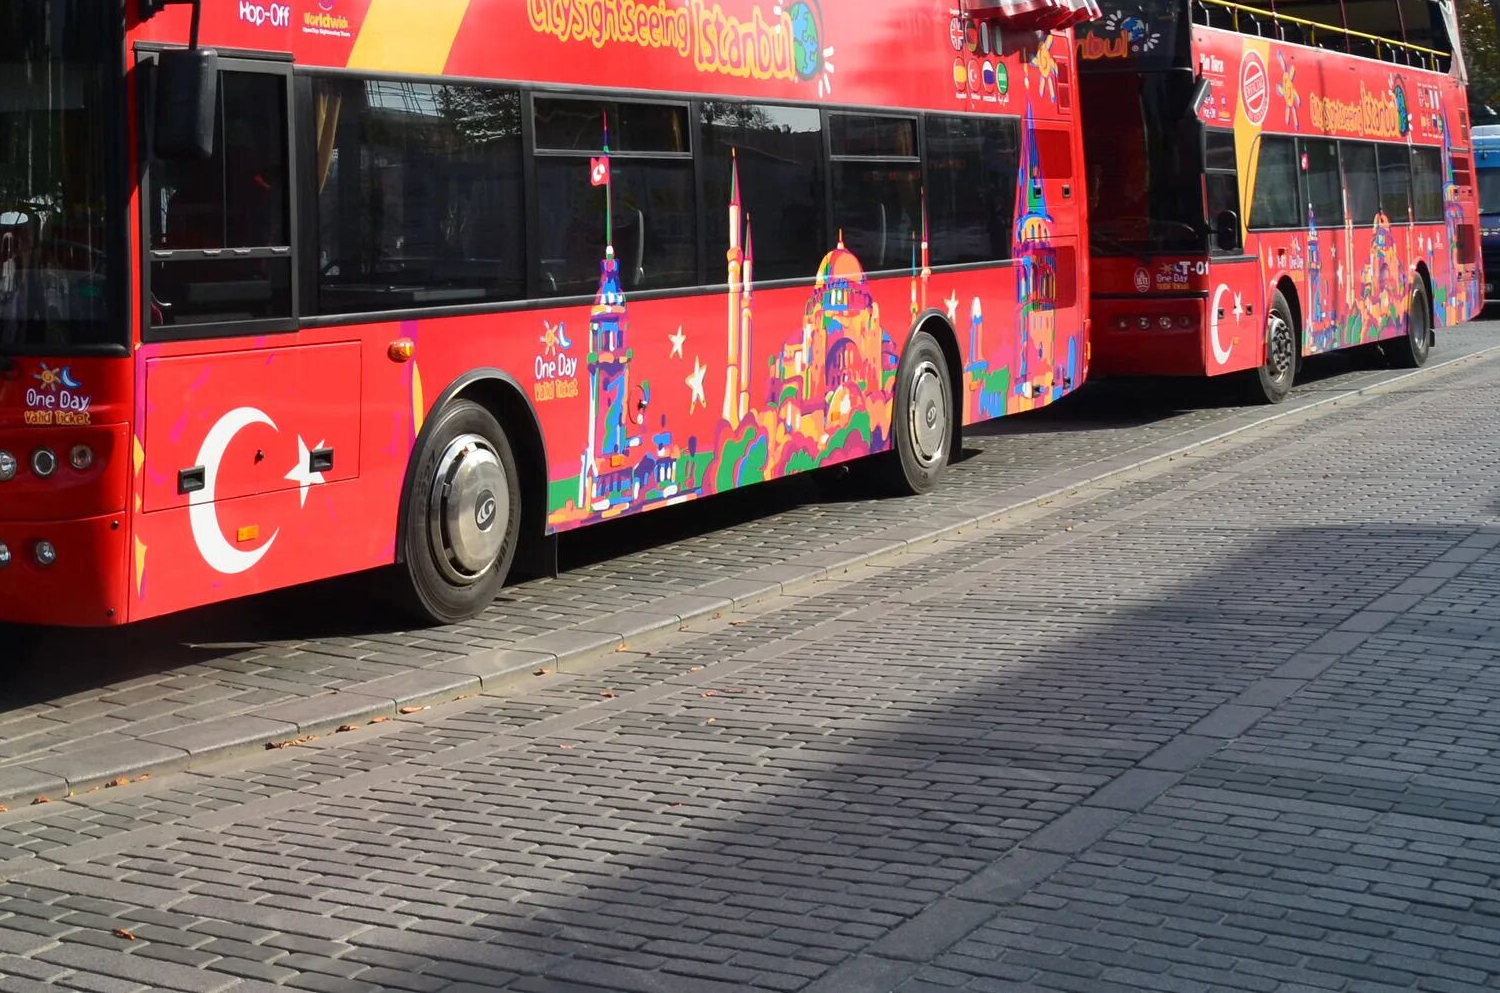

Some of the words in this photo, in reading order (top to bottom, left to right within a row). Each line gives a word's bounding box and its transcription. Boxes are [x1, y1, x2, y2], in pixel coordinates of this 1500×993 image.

[239, 0, 290, 26] Hop-Off
[535, 355, 556, 380] One
[558, 353, 578, 378] Day
[26, 388, 55, 408] One
[60, 390, 90, 412] Day
[54, 410, 92, 425] Ticket
